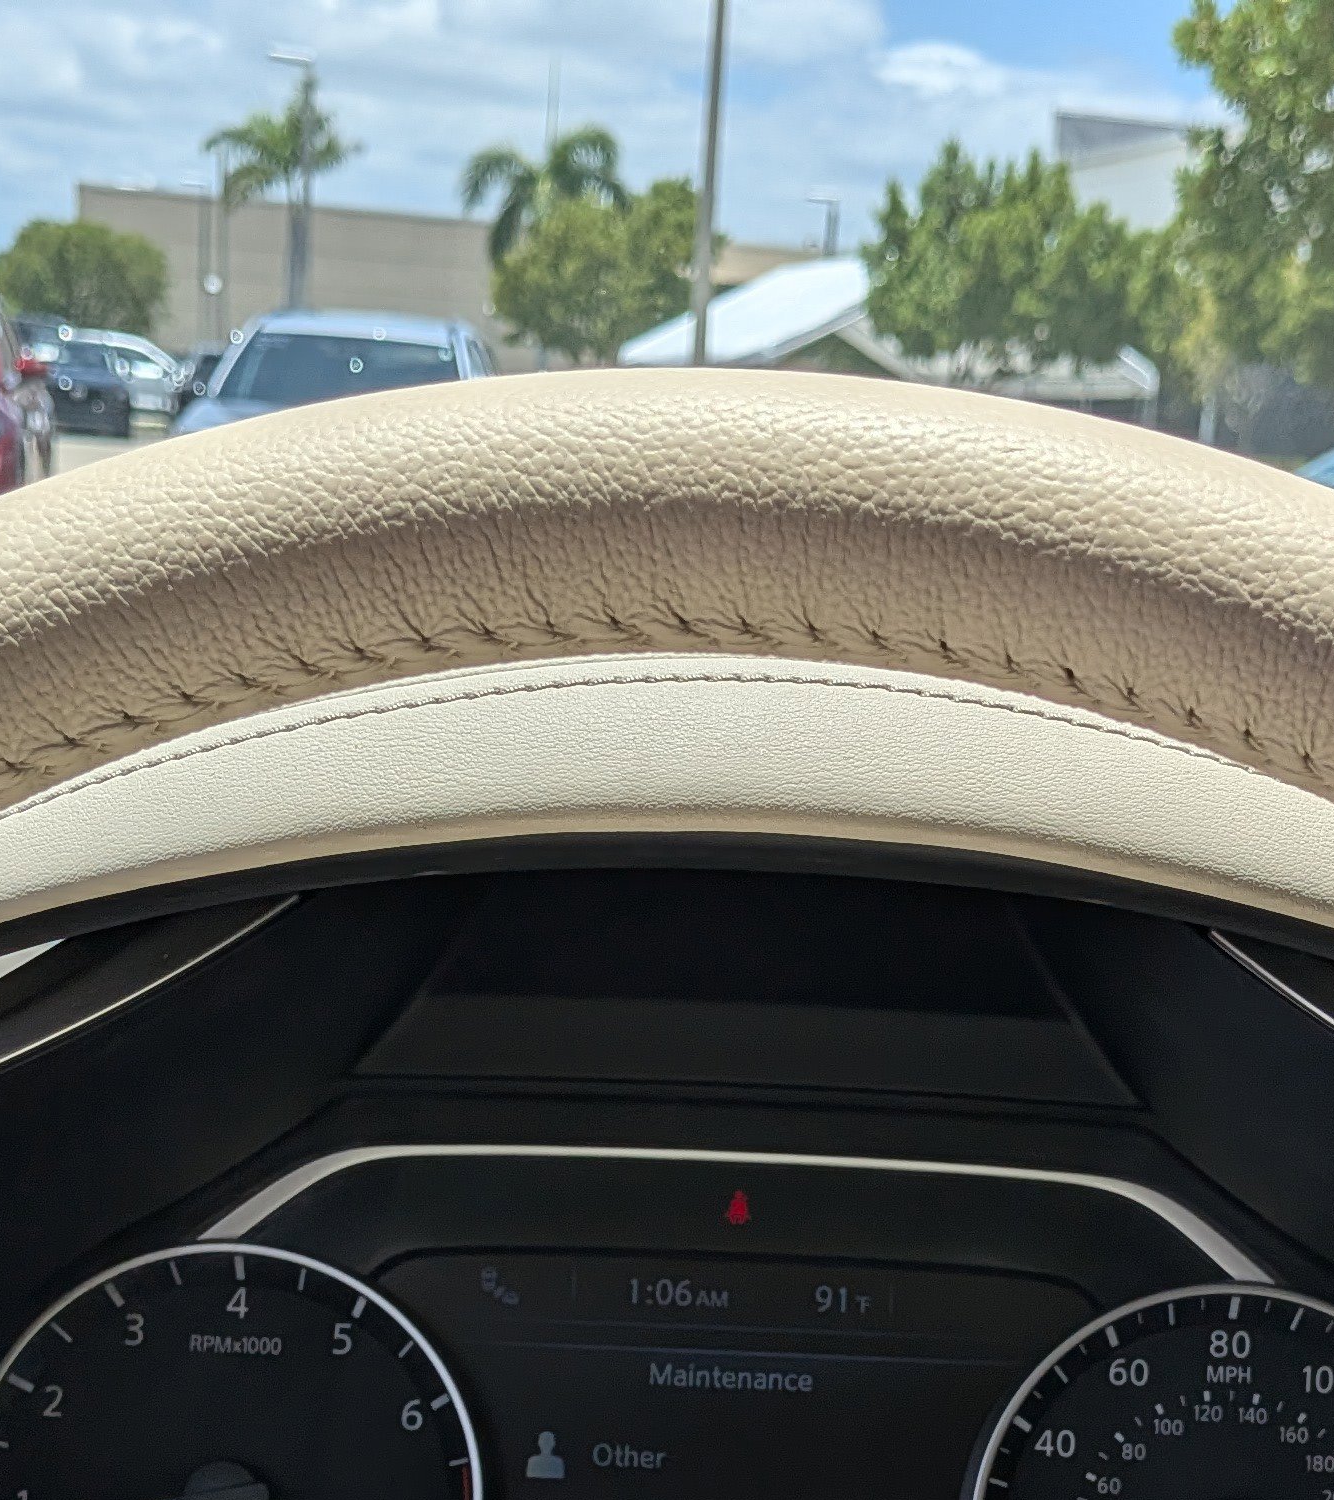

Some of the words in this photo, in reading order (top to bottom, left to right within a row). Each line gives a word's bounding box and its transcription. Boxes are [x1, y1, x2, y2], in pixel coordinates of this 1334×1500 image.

[226, 1287, 249, 1319] 4
[124, 1313, 144, 1346] 3
[332, 1322, 352, 1355] 5
[1209, 1329, 1251, 1359] 80
[649, 1362, 813, 1392] Maintenance
[1108, 1358, 1149, 1387] 60
[1206, 1365, 1251, 1384] MPH
[43, 1385, 63, 1418] 2
[401, 1399, 423, 1431] 6
[1193, 1404, 1223, 1423] 120
[1238, 1406, 1268, 1425] 140
[1153, 1418, 1184, 1436] 100
[1279, 1426, 1309, 1444] 160
[592, 1443, 666, 1469] Other
[1034, 1429, 1076, 1458] 40
[1121, 1442, 1147, 1461] 80
[1098, 1477, 1122, 1495] 60
